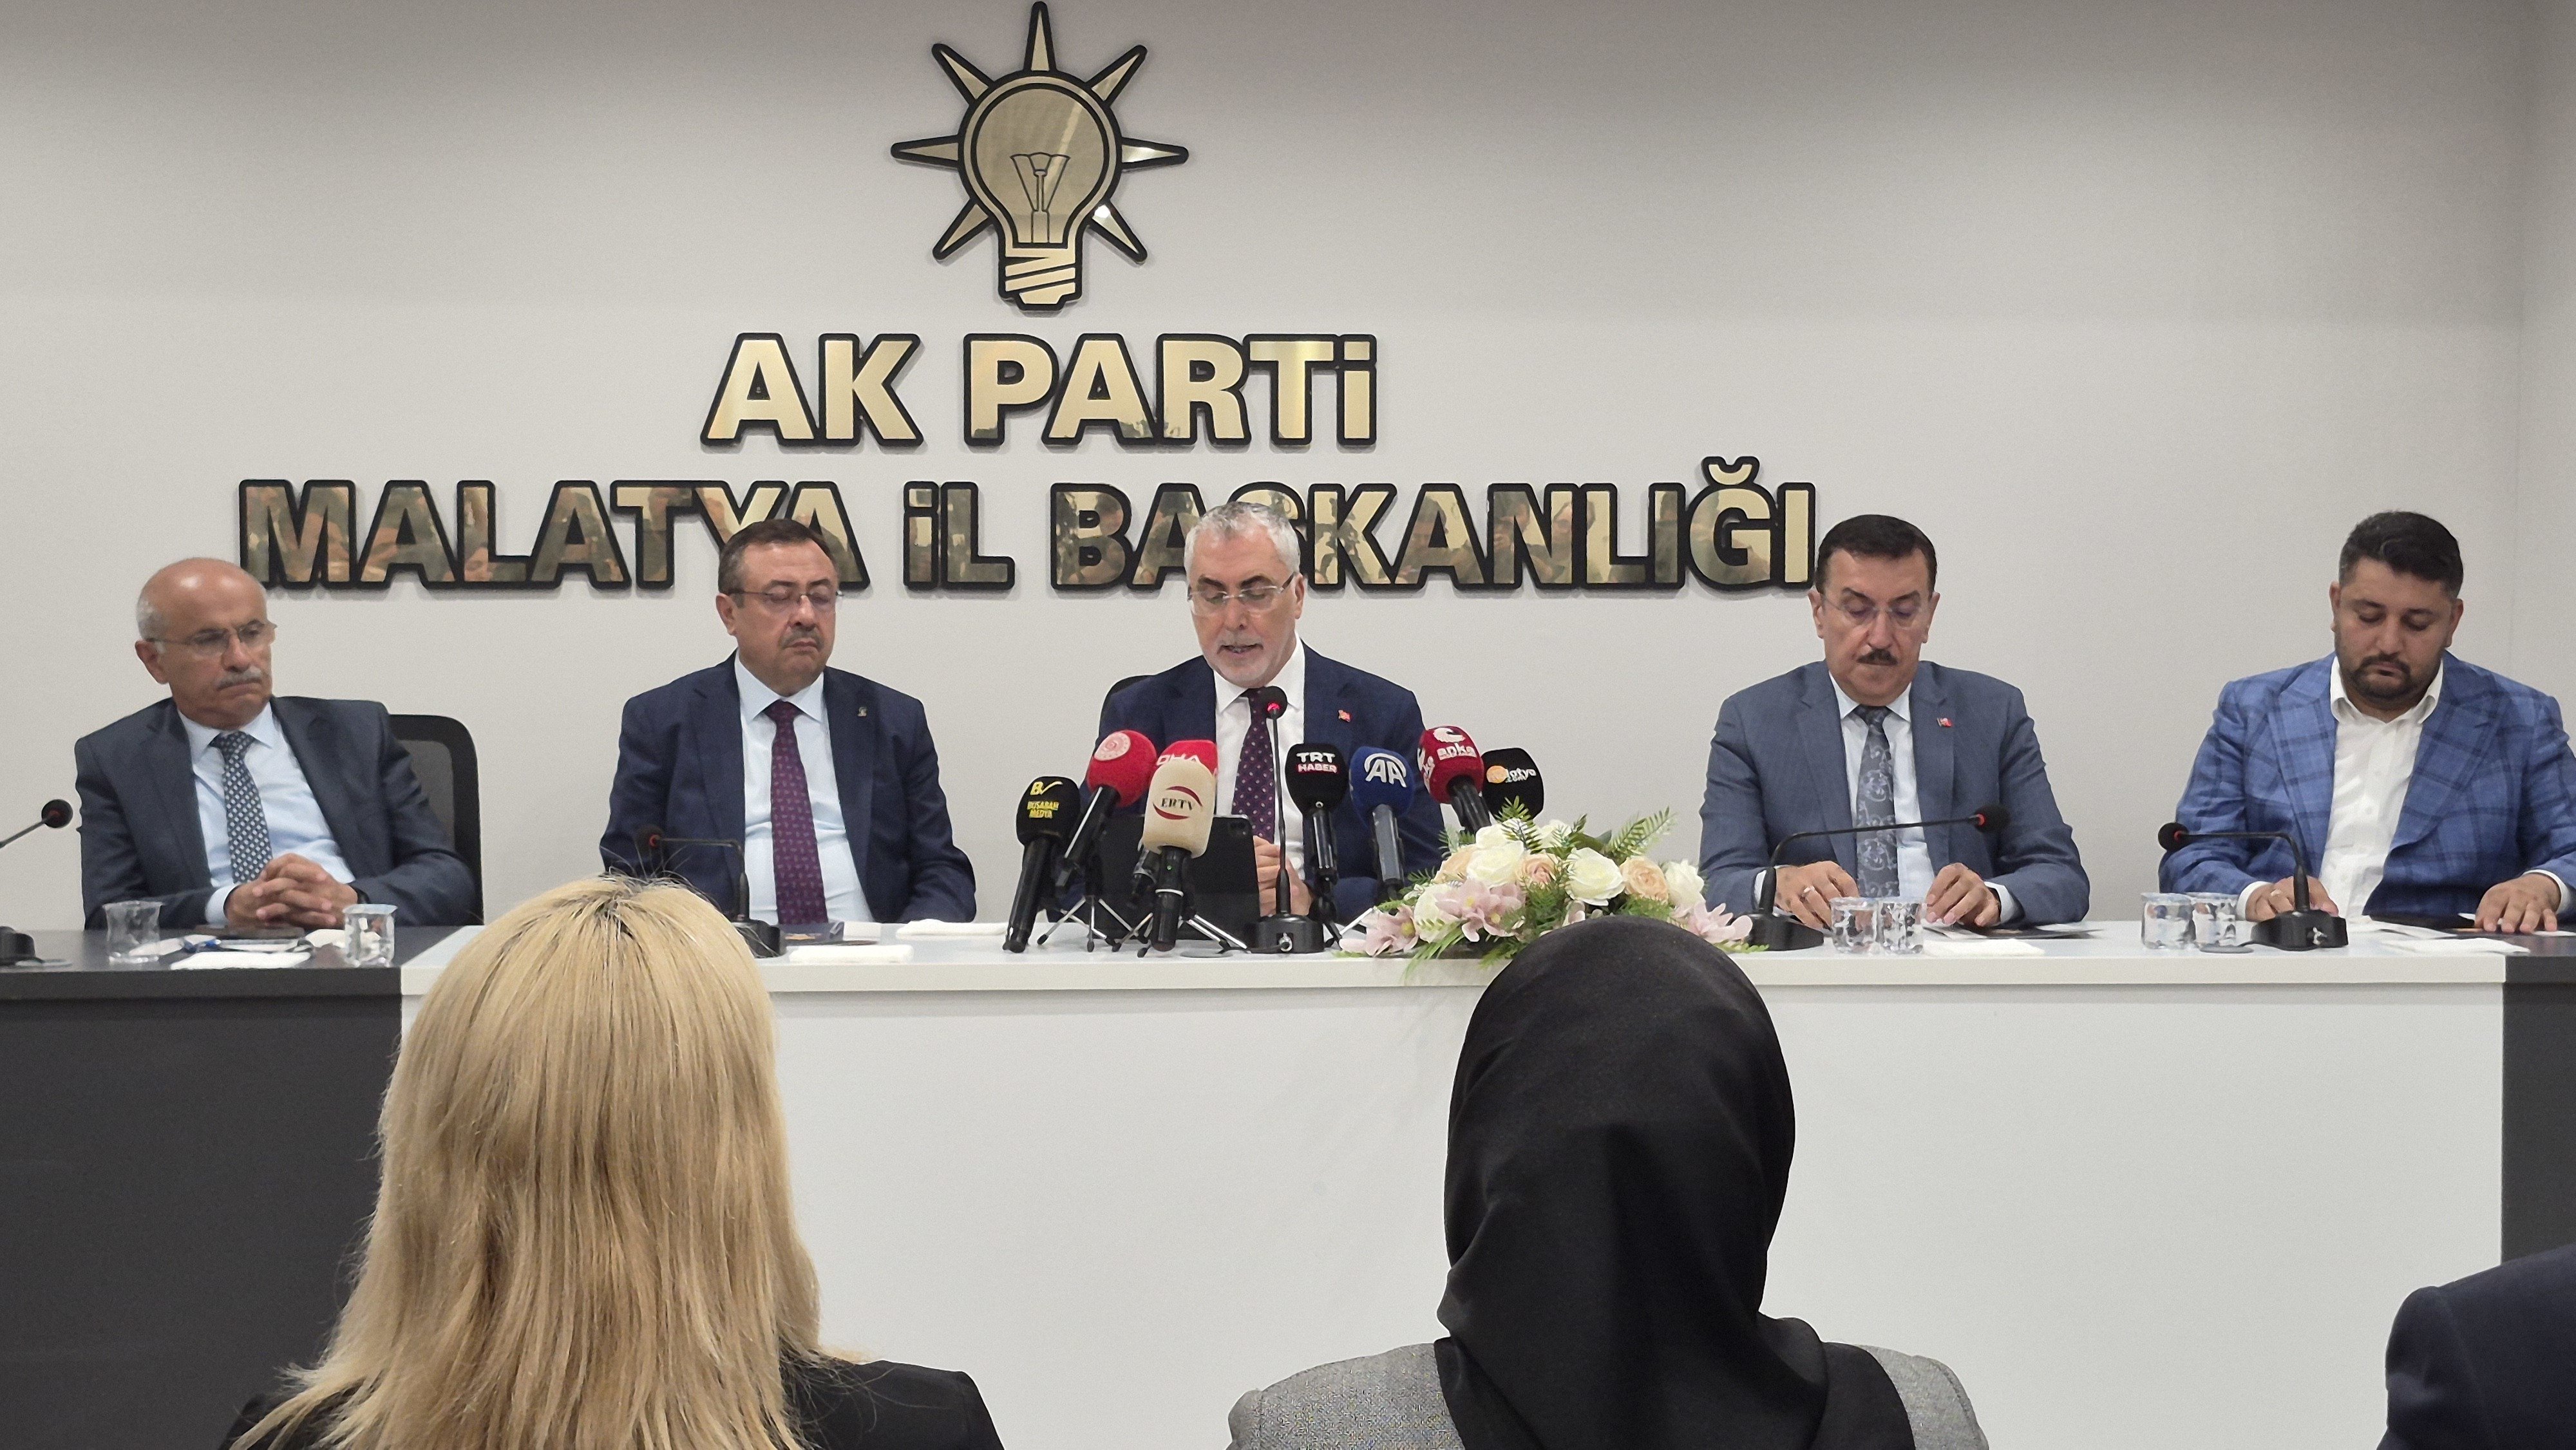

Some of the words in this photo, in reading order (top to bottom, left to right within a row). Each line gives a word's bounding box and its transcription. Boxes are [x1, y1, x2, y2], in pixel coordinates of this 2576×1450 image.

[701, 333, 923, 447] AK
[1296, 752, 1335, 763] TRT
[1298, 763, 1338, 773] HABER
[1365, 759, 1407, 788] AA
